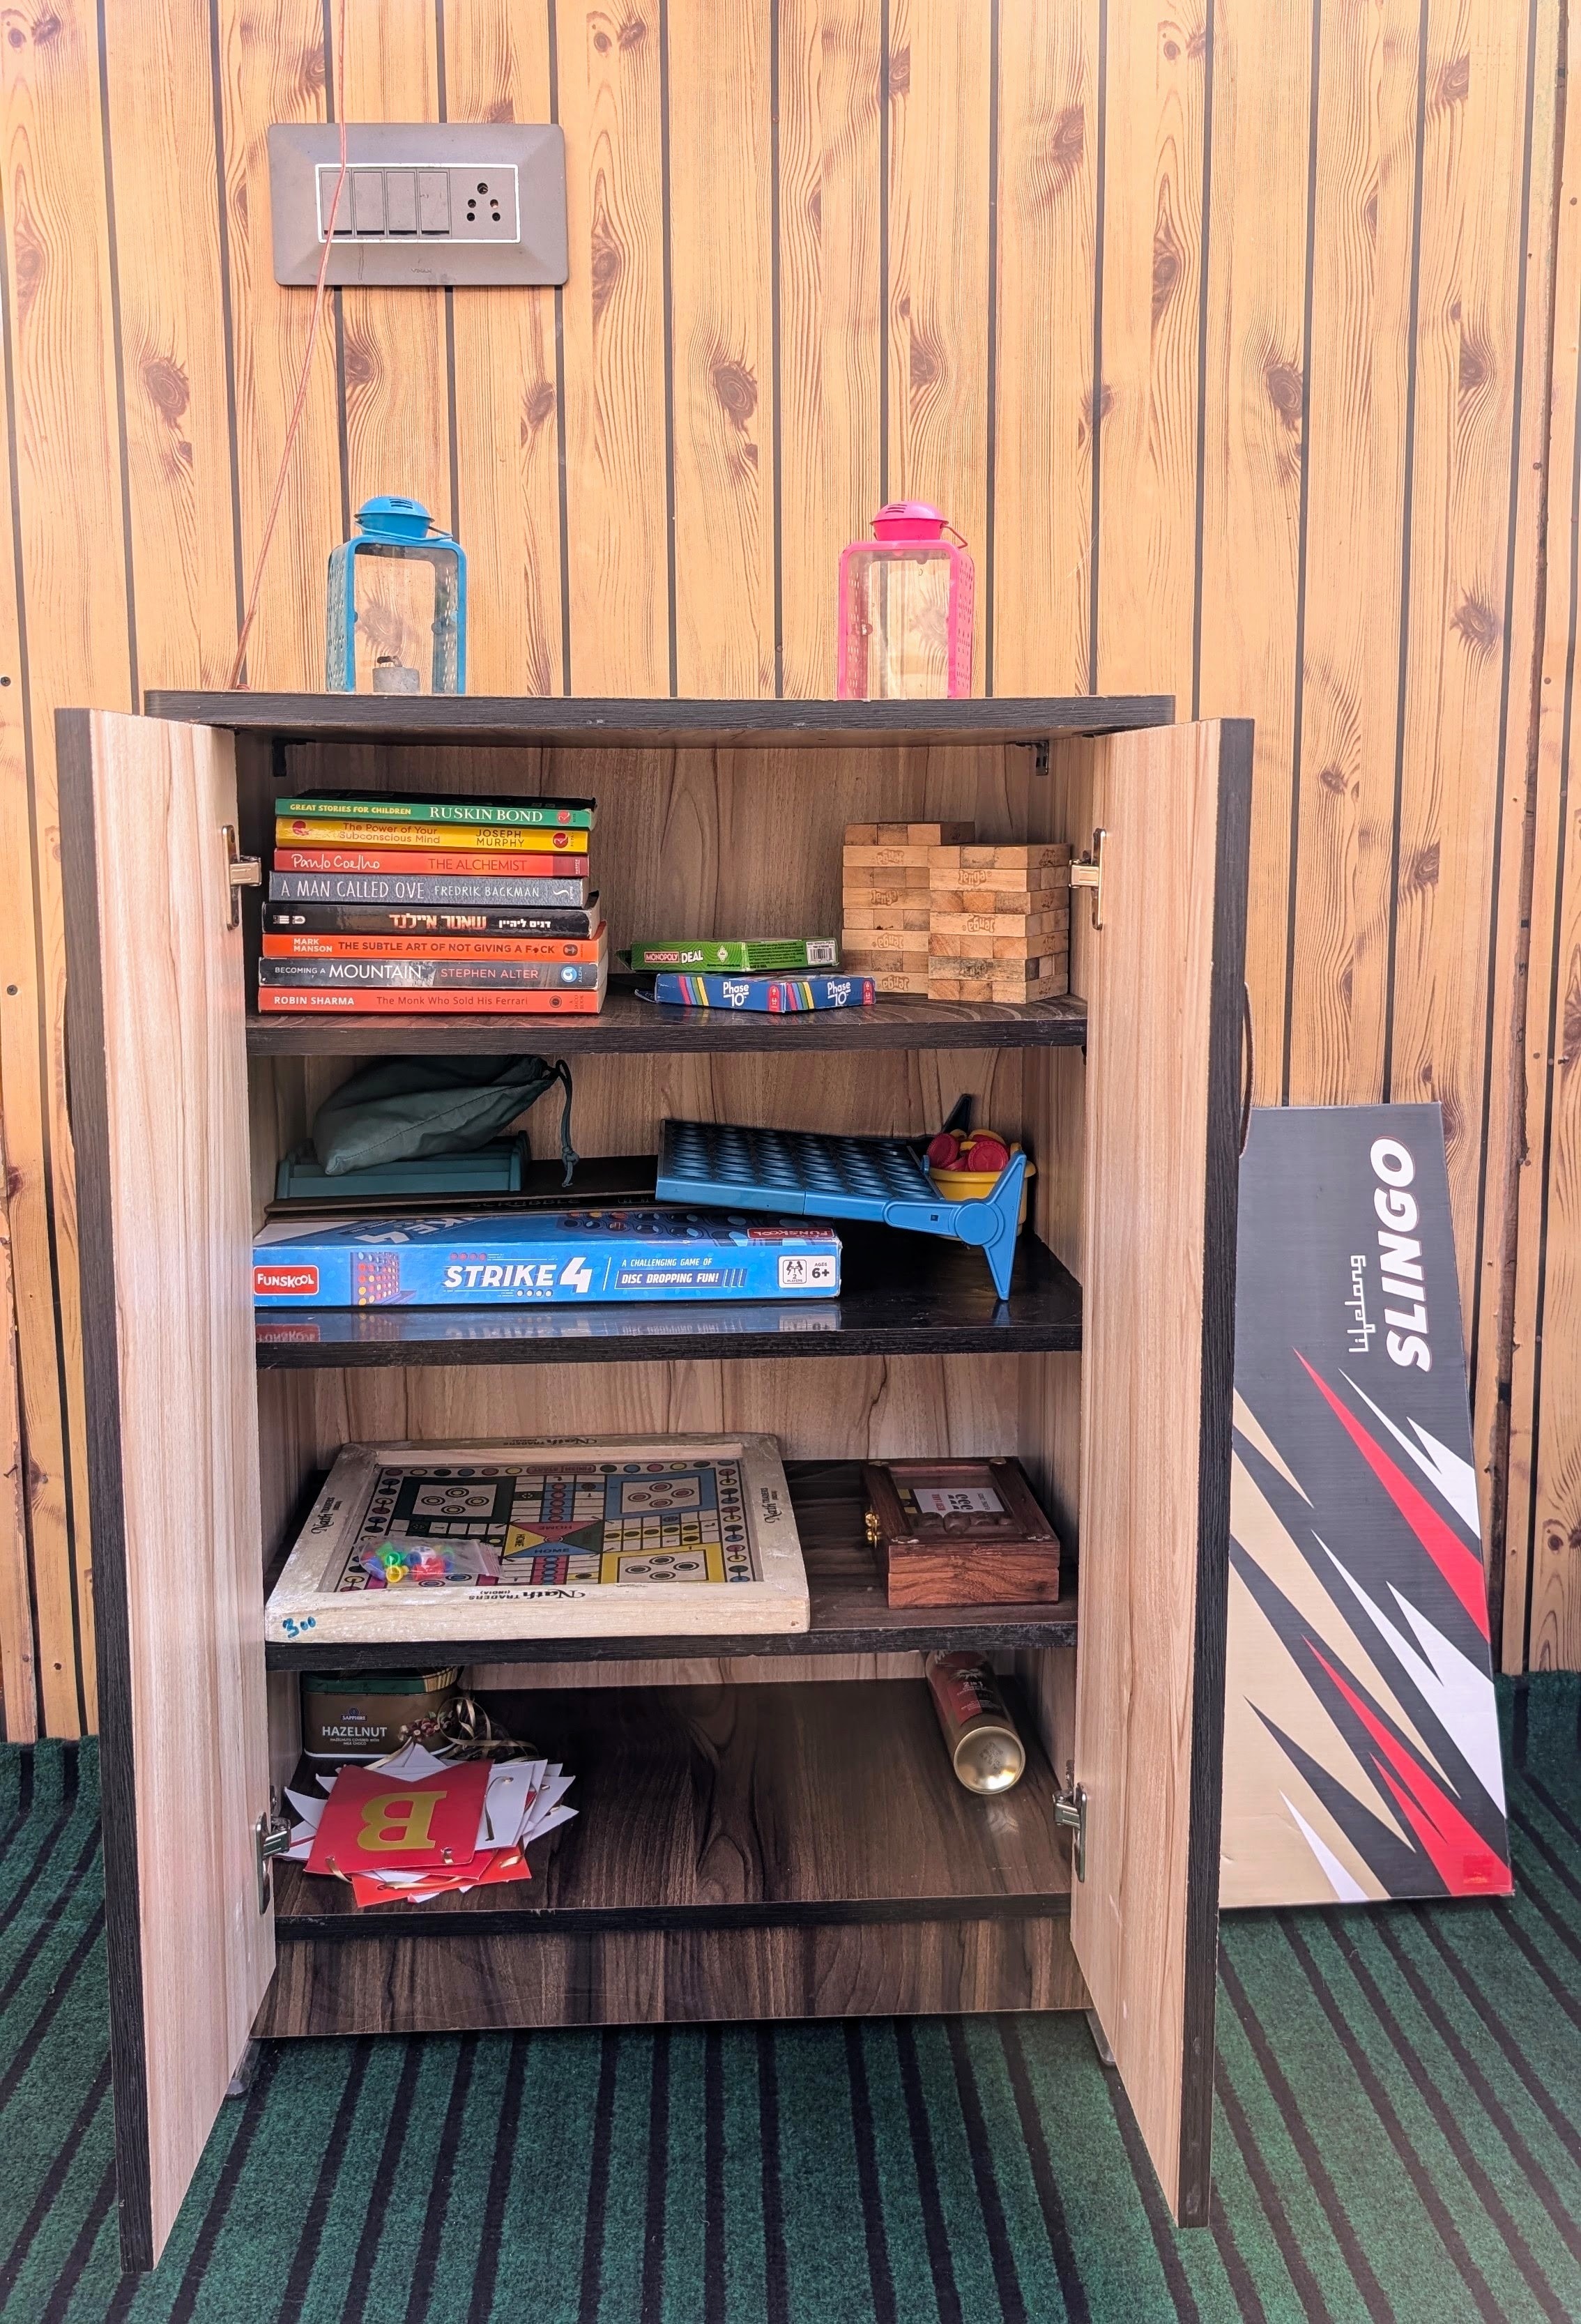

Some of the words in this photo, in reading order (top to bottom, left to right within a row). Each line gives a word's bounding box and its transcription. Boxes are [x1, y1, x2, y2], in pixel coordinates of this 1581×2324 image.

[319, 804, 351, 813] STORIES
[372, 806, 411, 815] CHILDREN
[429, 806, 492, 820] RUSKIN
[497, 809, 543, 823] BOND
[343, 823, 362, 831] The
[366, 824, 397, 832] Power
[401, 825, 412, 833] of
[414, 825, 437, 834] Your
[476, 829, 521, 839] JOSEPH
[339, 831, 411, 843] Subconscious
[415, 835, 440, 843] Mind
[477, 838, 525, 848] MURPHY
[291, 853, 330, 869] Paulo
[333, 854, 380, 871] Coelho
[428, 858, 452, 870] THE
[456, 859, 527, 871] ALCHEMIST
[958, 871, 987, 885] Jenga
[281, 880, 290, 897] A
[297, 880, 330, 897] MAN
[337, 881, 389, 898] CALLED
[395, 882, 425, 899] OVE
[434, 885, 480, 896] FREDRIK
[485, 887, 540, 897] BACKMAN
[498, 918, 526, 928] ליהיין
[530, 920, 551, 928] דניס
[967, 916, 995, 933] Jenga
[338, 942, 359, 950] THE
[362, 942, 403, 951] SUBTLE
[474, 944, 511, 953] GIVING
[877, 935, 903, 949] Jenga
[646, 953, 678, 961] MONOPOLY
[680, 949, 703, 964] DEAL
[328, 965, 422, 979] MOUNTAIN
[441, 968, 496, 978] STEPHEN
[500, 970, 538, 979] ALTER
[723, 981, 749, 994] Phase
[827, 981, 851, 995] Phase
[881, 975, 909, 991] Jenga
[274, 996, 307, 1004] ROBIN
[311, 996, 354, 1005] SHARMA
[453, 997, 473, 1005] Sold
[478, 997, 492, 1005] His
[496, 997, 528, 1005] Ferrari
[731, 993, 745, 1007] 10
[834, 993, 848, 1007] 10
[1370, 1136, 1432, 1372] SLINGO
[630, 1259, 676, 1267] CHALLENGING
[444, 1264, 557, 1288] STRIKE
[560, 1257, 593, 1293] 4
[622, 1274, 642, 1284] DISC
[646, 1273, 692, 1283] DROPPING
[697, 1272, 719, 1283] FUN!
[812, 1268, 830, 1278] 6+
[257, 1273, 314, 1288] FUNSKOOL
[761, 1504, 782, 1523] Nath
[311, 1513, 334, 1534] Nath
[523, 1589, 586, 1599] Nath
[322, 1726, 388, 1737] HAZELNUT
[357, 1790, 448, 1851] B
